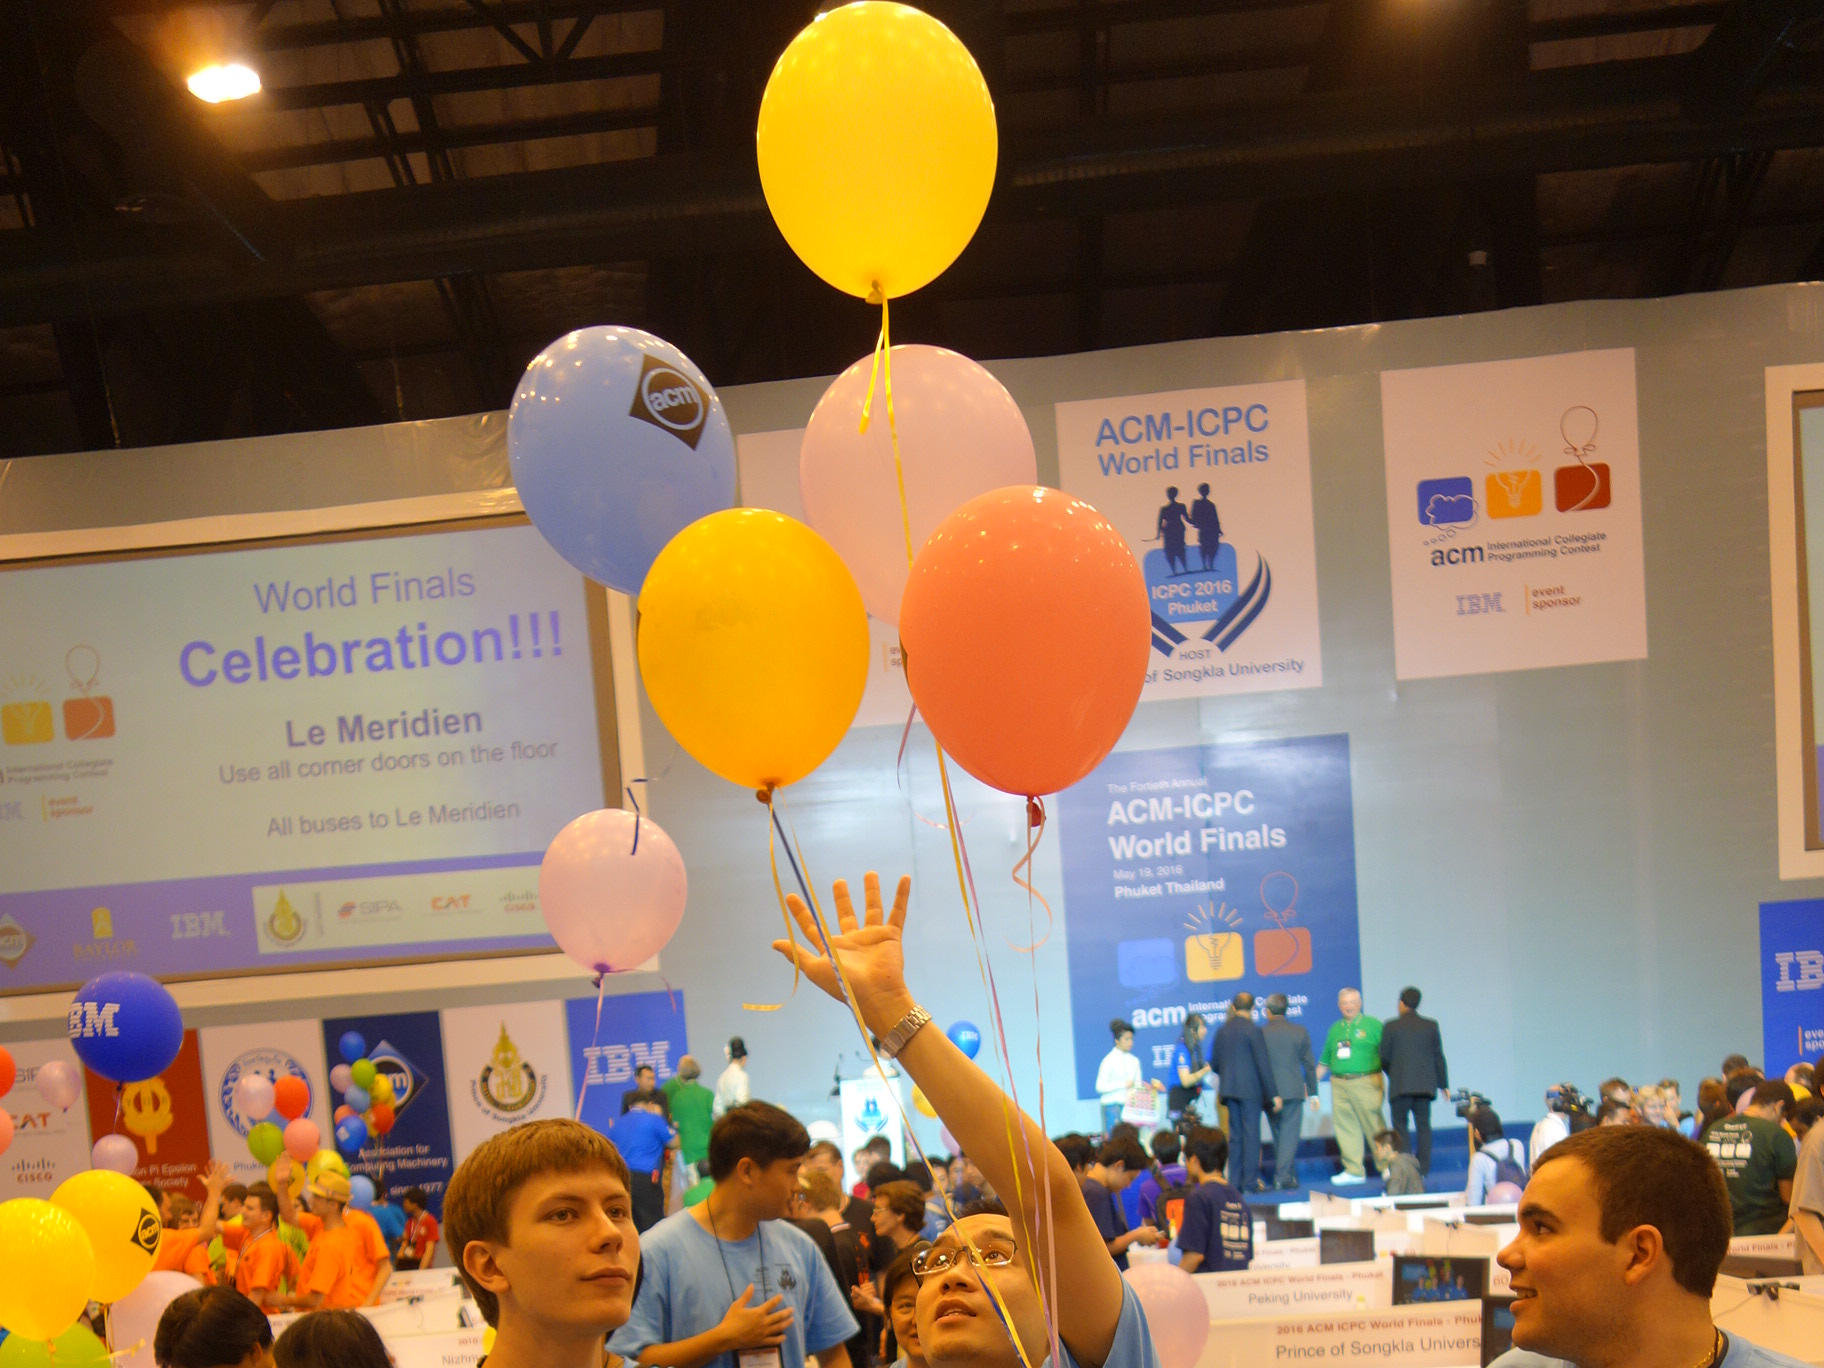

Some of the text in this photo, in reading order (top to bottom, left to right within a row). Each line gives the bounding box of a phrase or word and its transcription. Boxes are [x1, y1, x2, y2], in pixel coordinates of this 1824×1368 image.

[649, 386, 698, 411] acm
[1095, 403, 1269, 447] ACM-ICPC
[1097, 440, 1269, 476] World Finals
[1430, 531, 1607, 566] acm International Collegiate
[1487, 543, 1601, 562] Programming Contest
[254, 567, 475, 614] World Finals
[1151, 579, 1232, 599] ICPC 2016
[1531, 585, 1565, 597] event
[1168, 599, 1218, 616] Phuket
[1456, 592, 1505, 616] IBM
[1531, 595, 1581, 610] sponsor
[179, 610, 563, 688] Celebration!!!
[1179, 649, 1211, 660] HOST
[1163, 664, 1225, 682] Songkla
[1228, 658, 1304, 676] University
[285, 708, 482, 747] Le Meridien
[219, 740, 560, 784] Use all corner doors on the floor
[267, 800, 520, 837] All buses to Le Meridien
[1107, 789, 1255, 825] ACM-ICPC
[1108, 823, 1287, 861] World Finals
[1114, 878, 1225, 899] Phuket Thailand
[170, 910, 231, 940] IBM
[1131, 1004, 1186, 1028] acm
[583, 1040, 673, 1085] IBM
[1248, 1288, 1353, 1306] Peking University
[1276, 1314, 1482, 1335] 2016 ACM ICPC World Finals Phuk
[1276, 1335, 1482, 1360] Prince of Songkla Univers
